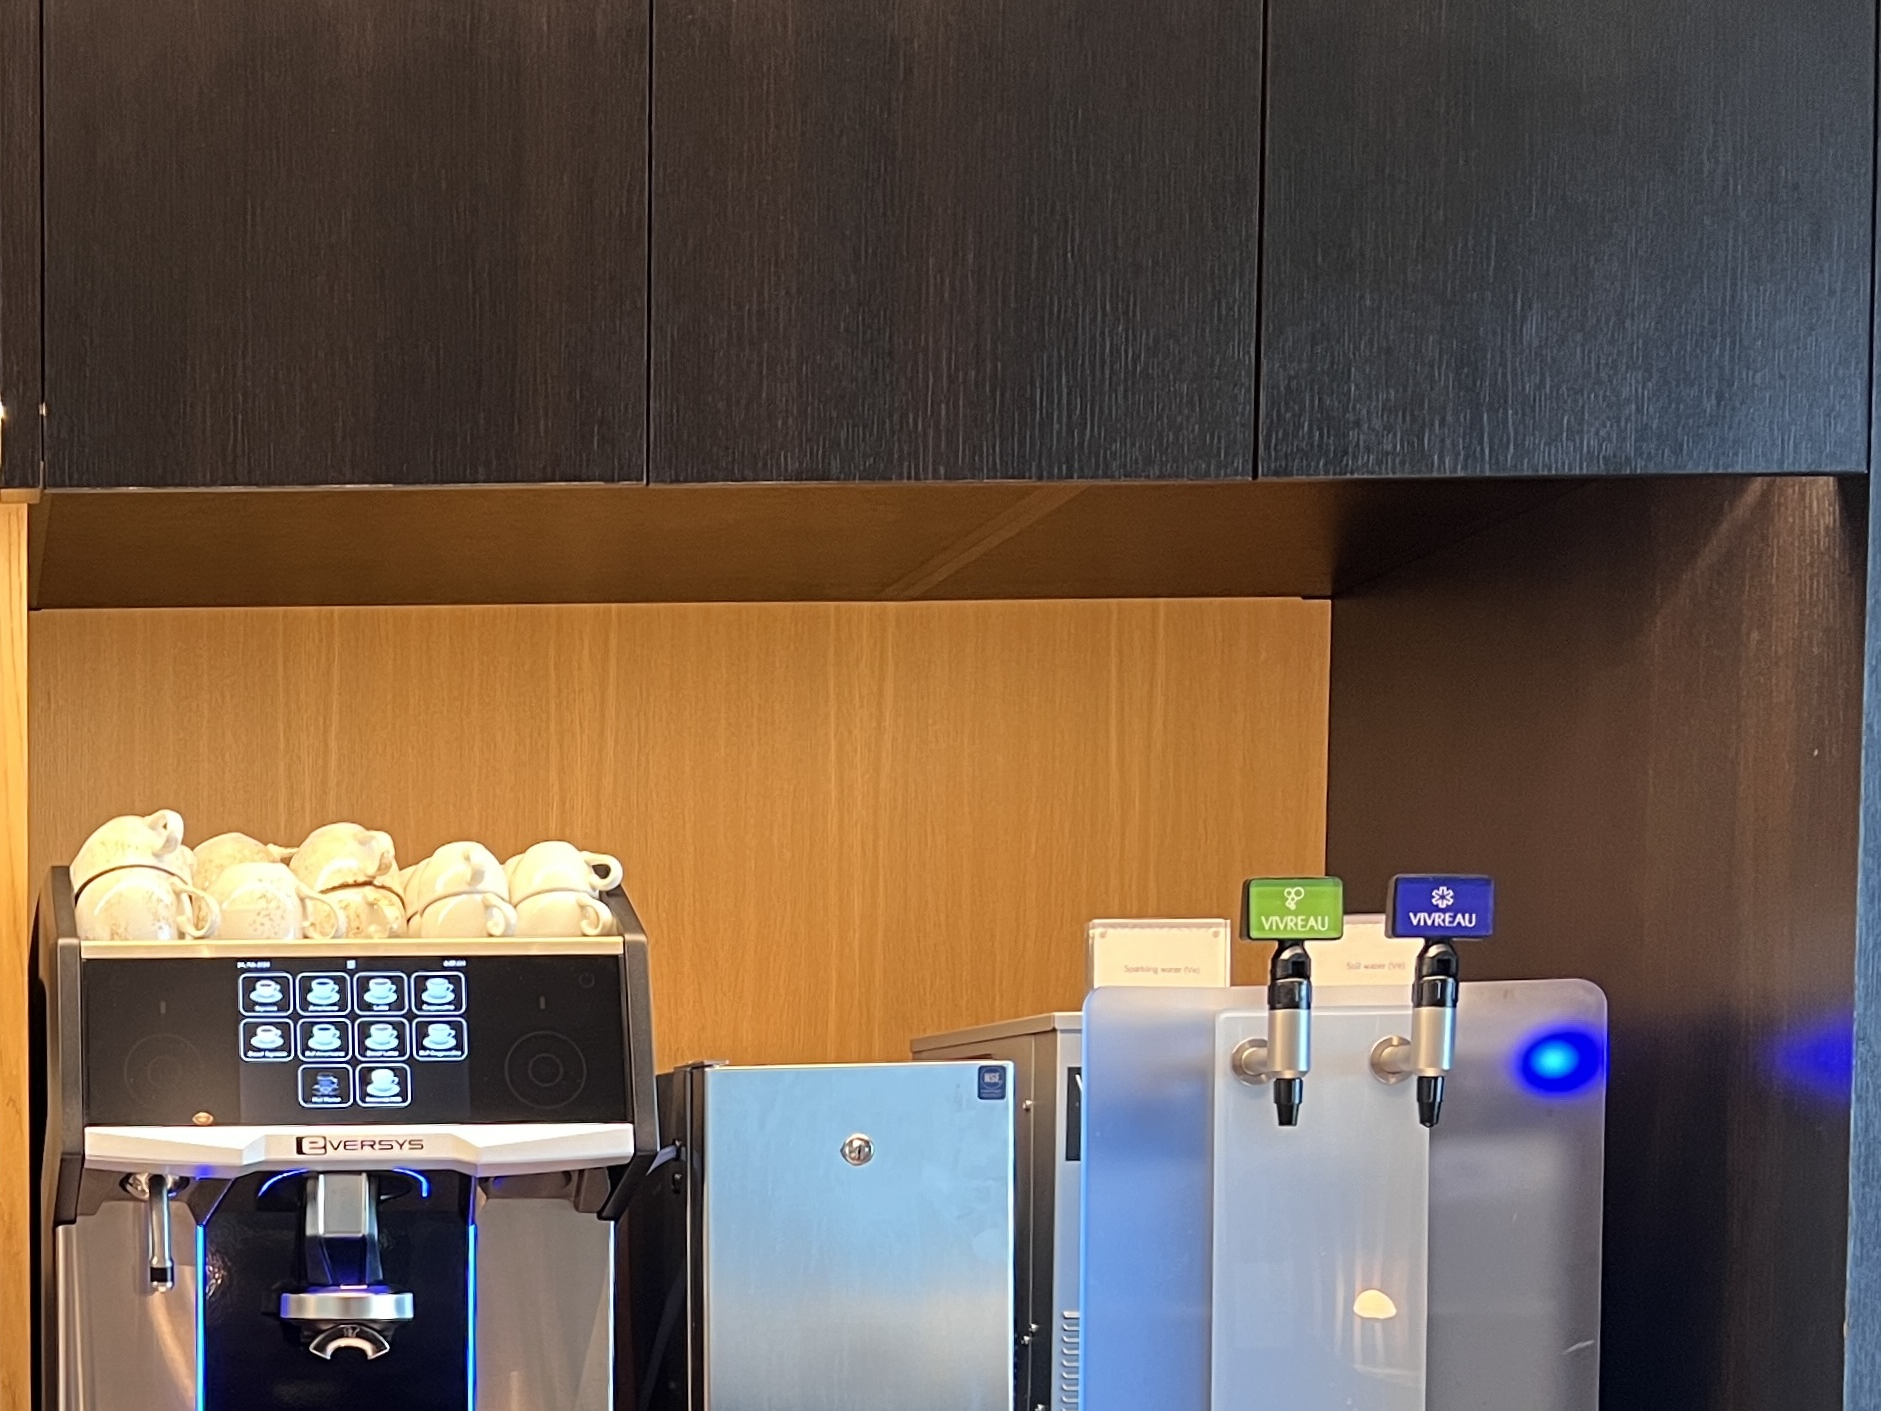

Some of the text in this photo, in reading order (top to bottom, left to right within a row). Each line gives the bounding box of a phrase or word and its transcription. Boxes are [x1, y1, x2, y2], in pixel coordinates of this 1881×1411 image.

[1261, 916, 1329, 931] VIVREAU
[1409, 912, 1477, 927] VIVREAU
[1123, 964, 1159, 975] Sparkling
[983, 1072, 1001, 1083] NSF
